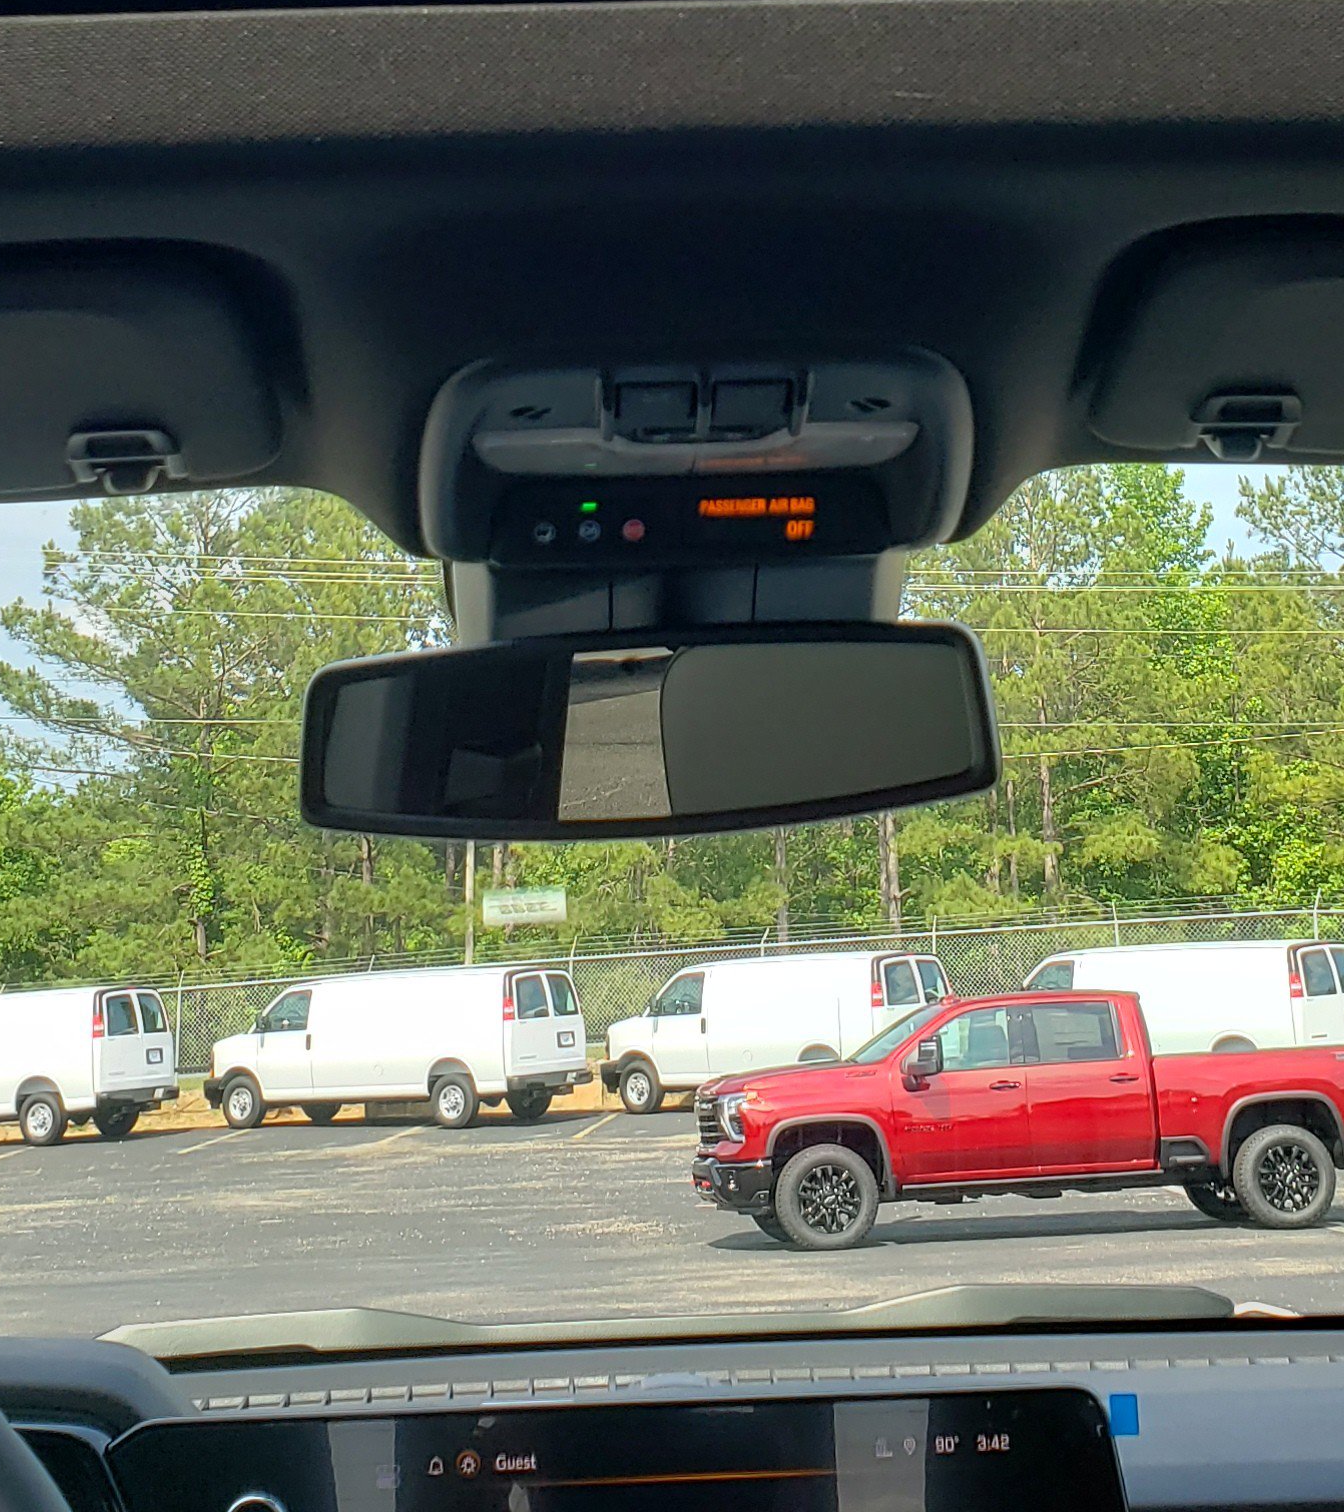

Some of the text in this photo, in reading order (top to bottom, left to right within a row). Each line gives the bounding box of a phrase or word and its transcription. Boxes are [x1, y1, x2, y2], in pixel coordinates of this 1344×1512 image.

[699, 498, 766, 517] PASSENGER
[785, 519, 815, 540] OFF
[977, 1432, 1010, 1453] 3:42
[495, 1451, 537, 1471] Guest
